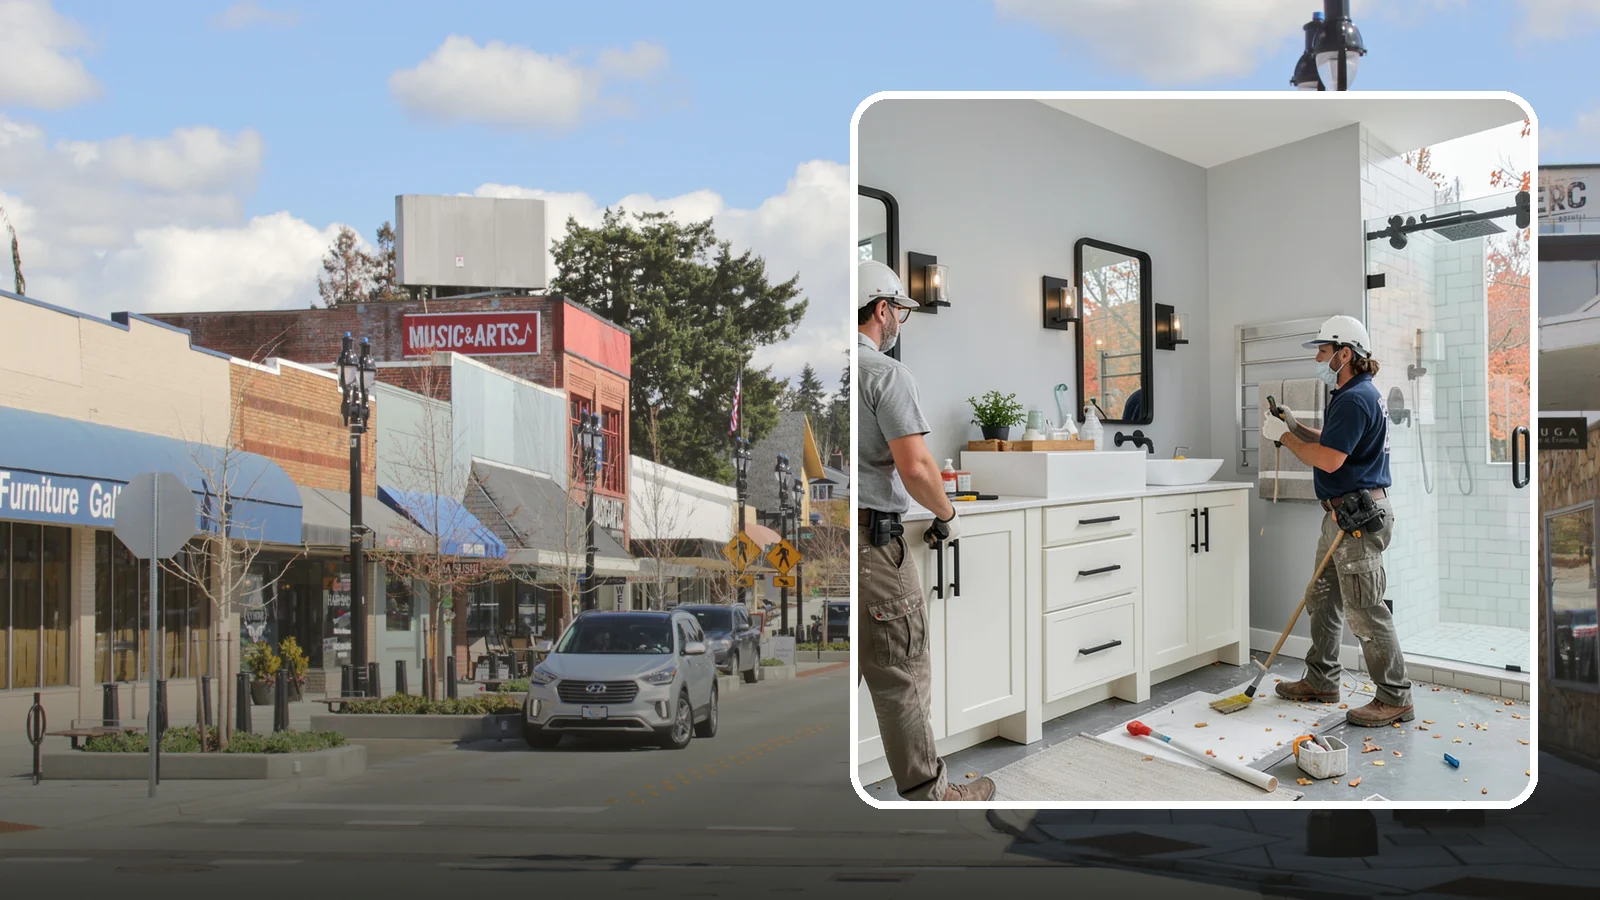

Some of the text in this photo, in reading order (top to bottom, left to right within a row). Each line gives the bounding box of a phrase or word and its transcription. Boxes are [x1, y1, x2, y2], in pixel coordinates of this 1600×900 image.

[408, 323, 520, 349] MUSIC&ARTS
[0, 471, 122, 519] Furniture Gal
[453, 563, 479, 574] SUSHI
